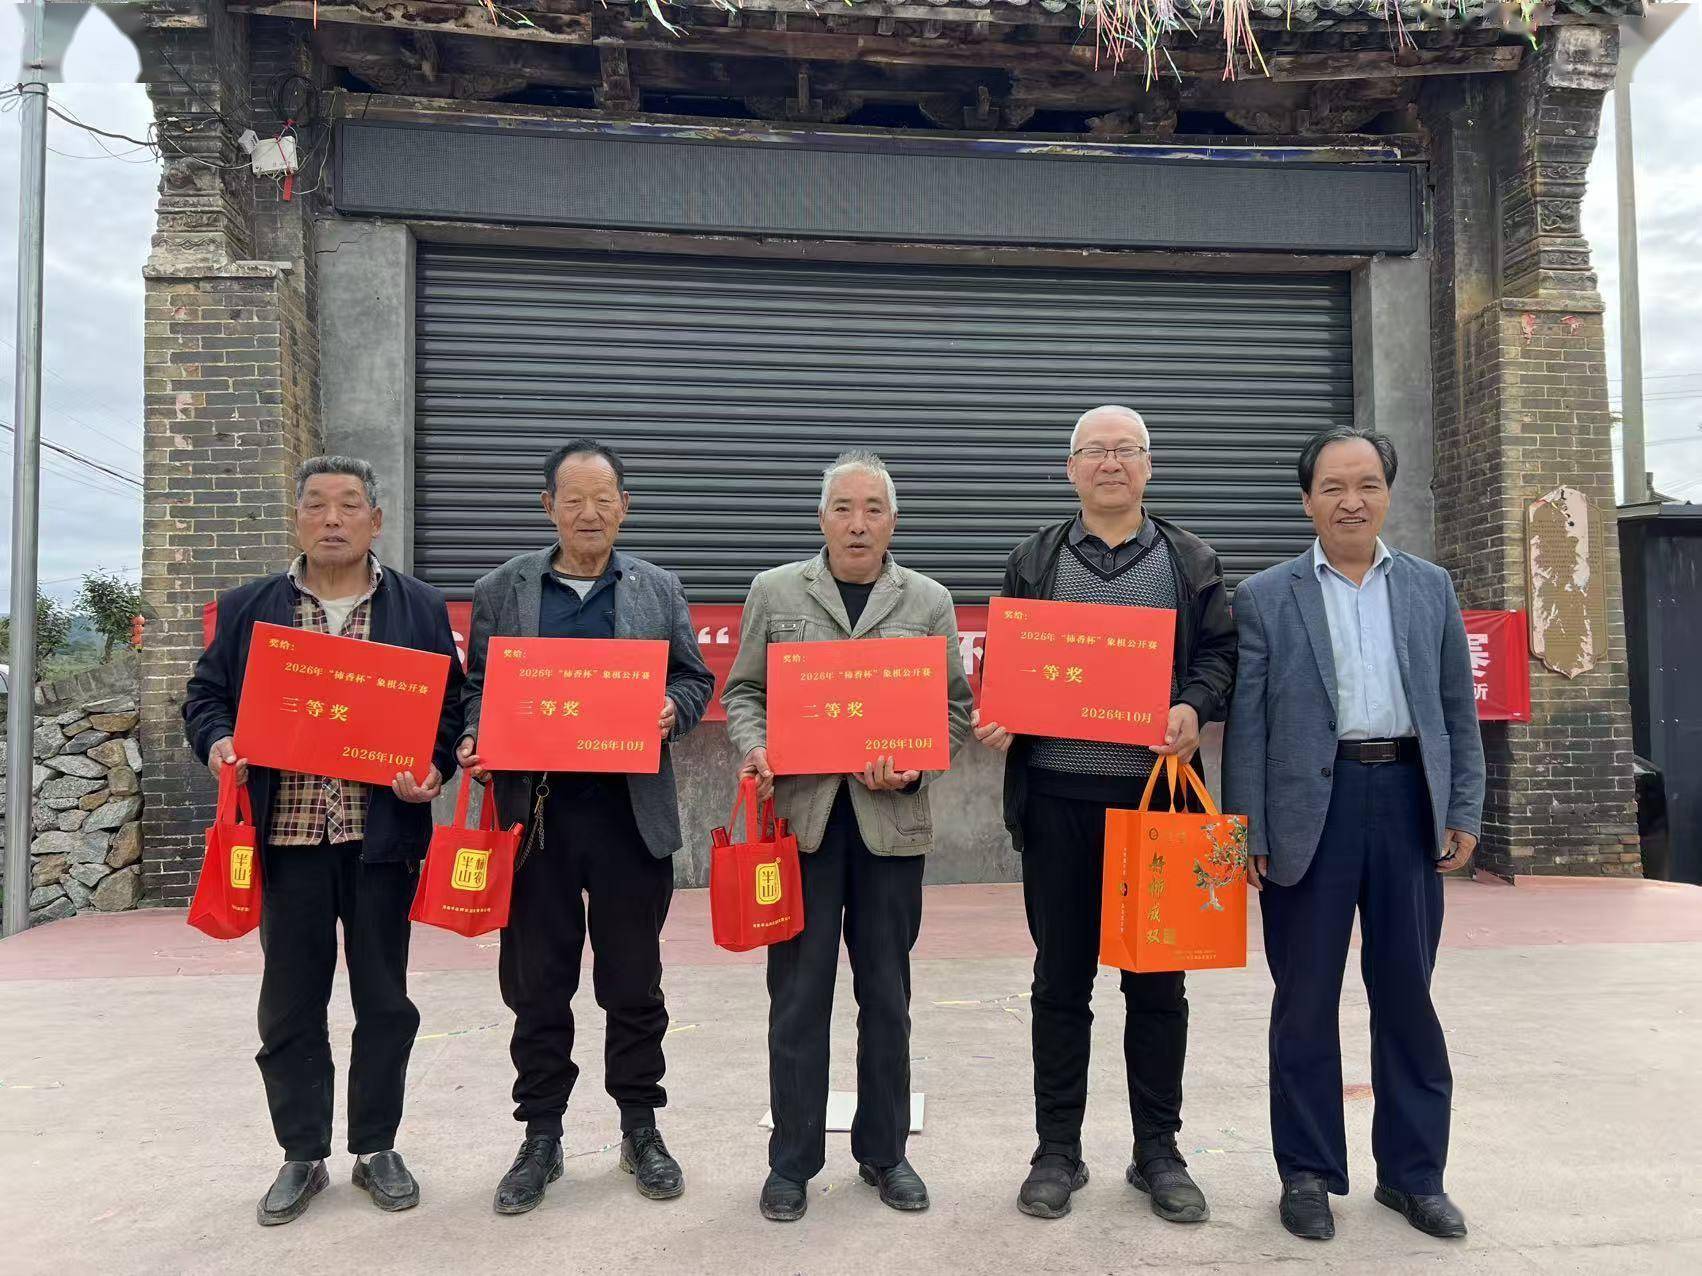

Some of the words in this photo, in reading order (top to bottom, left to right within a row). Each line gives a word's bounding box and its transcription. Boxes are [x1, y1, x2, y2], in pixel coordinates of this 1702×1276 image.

[1019, 664, 1084, 684] 一等奖
[280, 696, 350, 722] 三等奖
[519, 699, 581, 717] 三等奖
[800, 702, 865, 719] 二等奖
[1080, 706, 1153, 724] 2026年10月
[577, 740, 645, 752] 2026年10月
[865, 737, 934, 751] 2026年10月
[342, 746, 416, 768] 2026年10月
